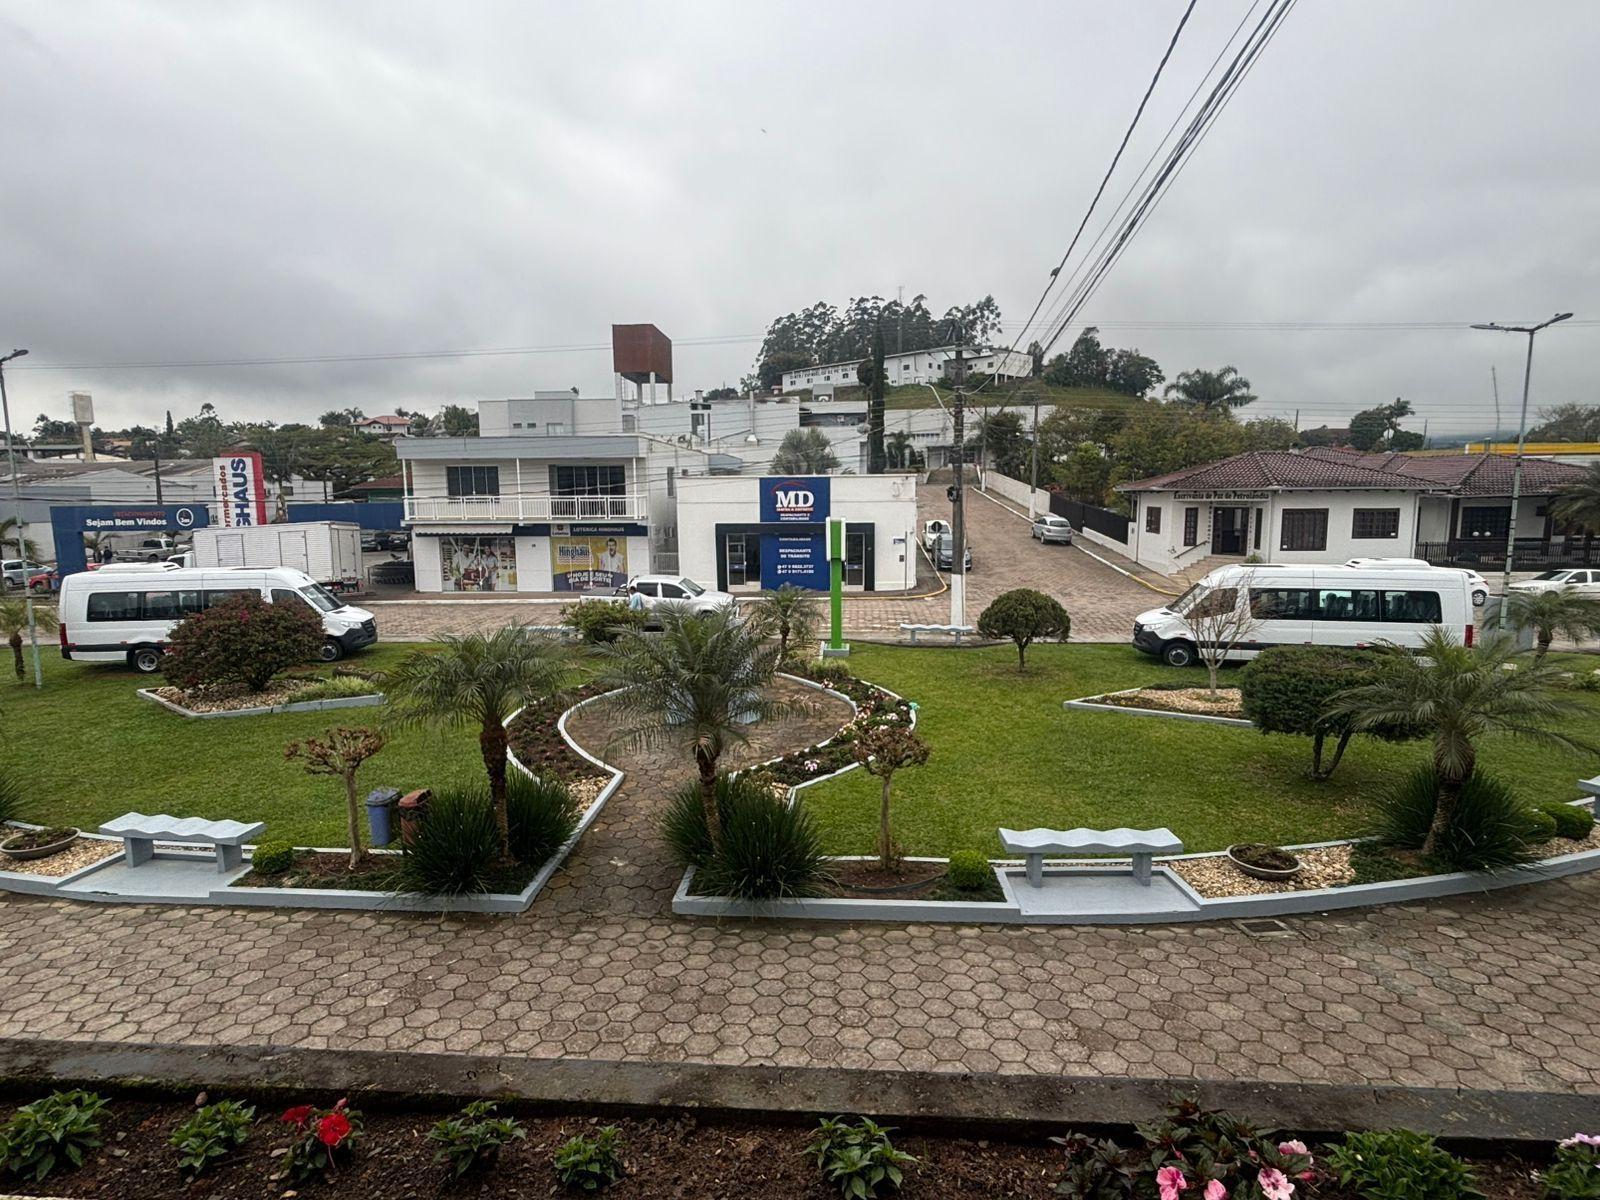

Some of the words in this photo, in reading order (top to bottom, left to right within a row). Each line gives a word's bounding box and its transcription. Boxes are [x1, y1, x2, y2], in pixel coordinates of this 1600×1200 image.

[775, 490, 815, 508] MD
[86, 518, 113, 527] Sejam
[115, 518, 135, 526] Bem
[135, 517, 167, 526] Vindos
